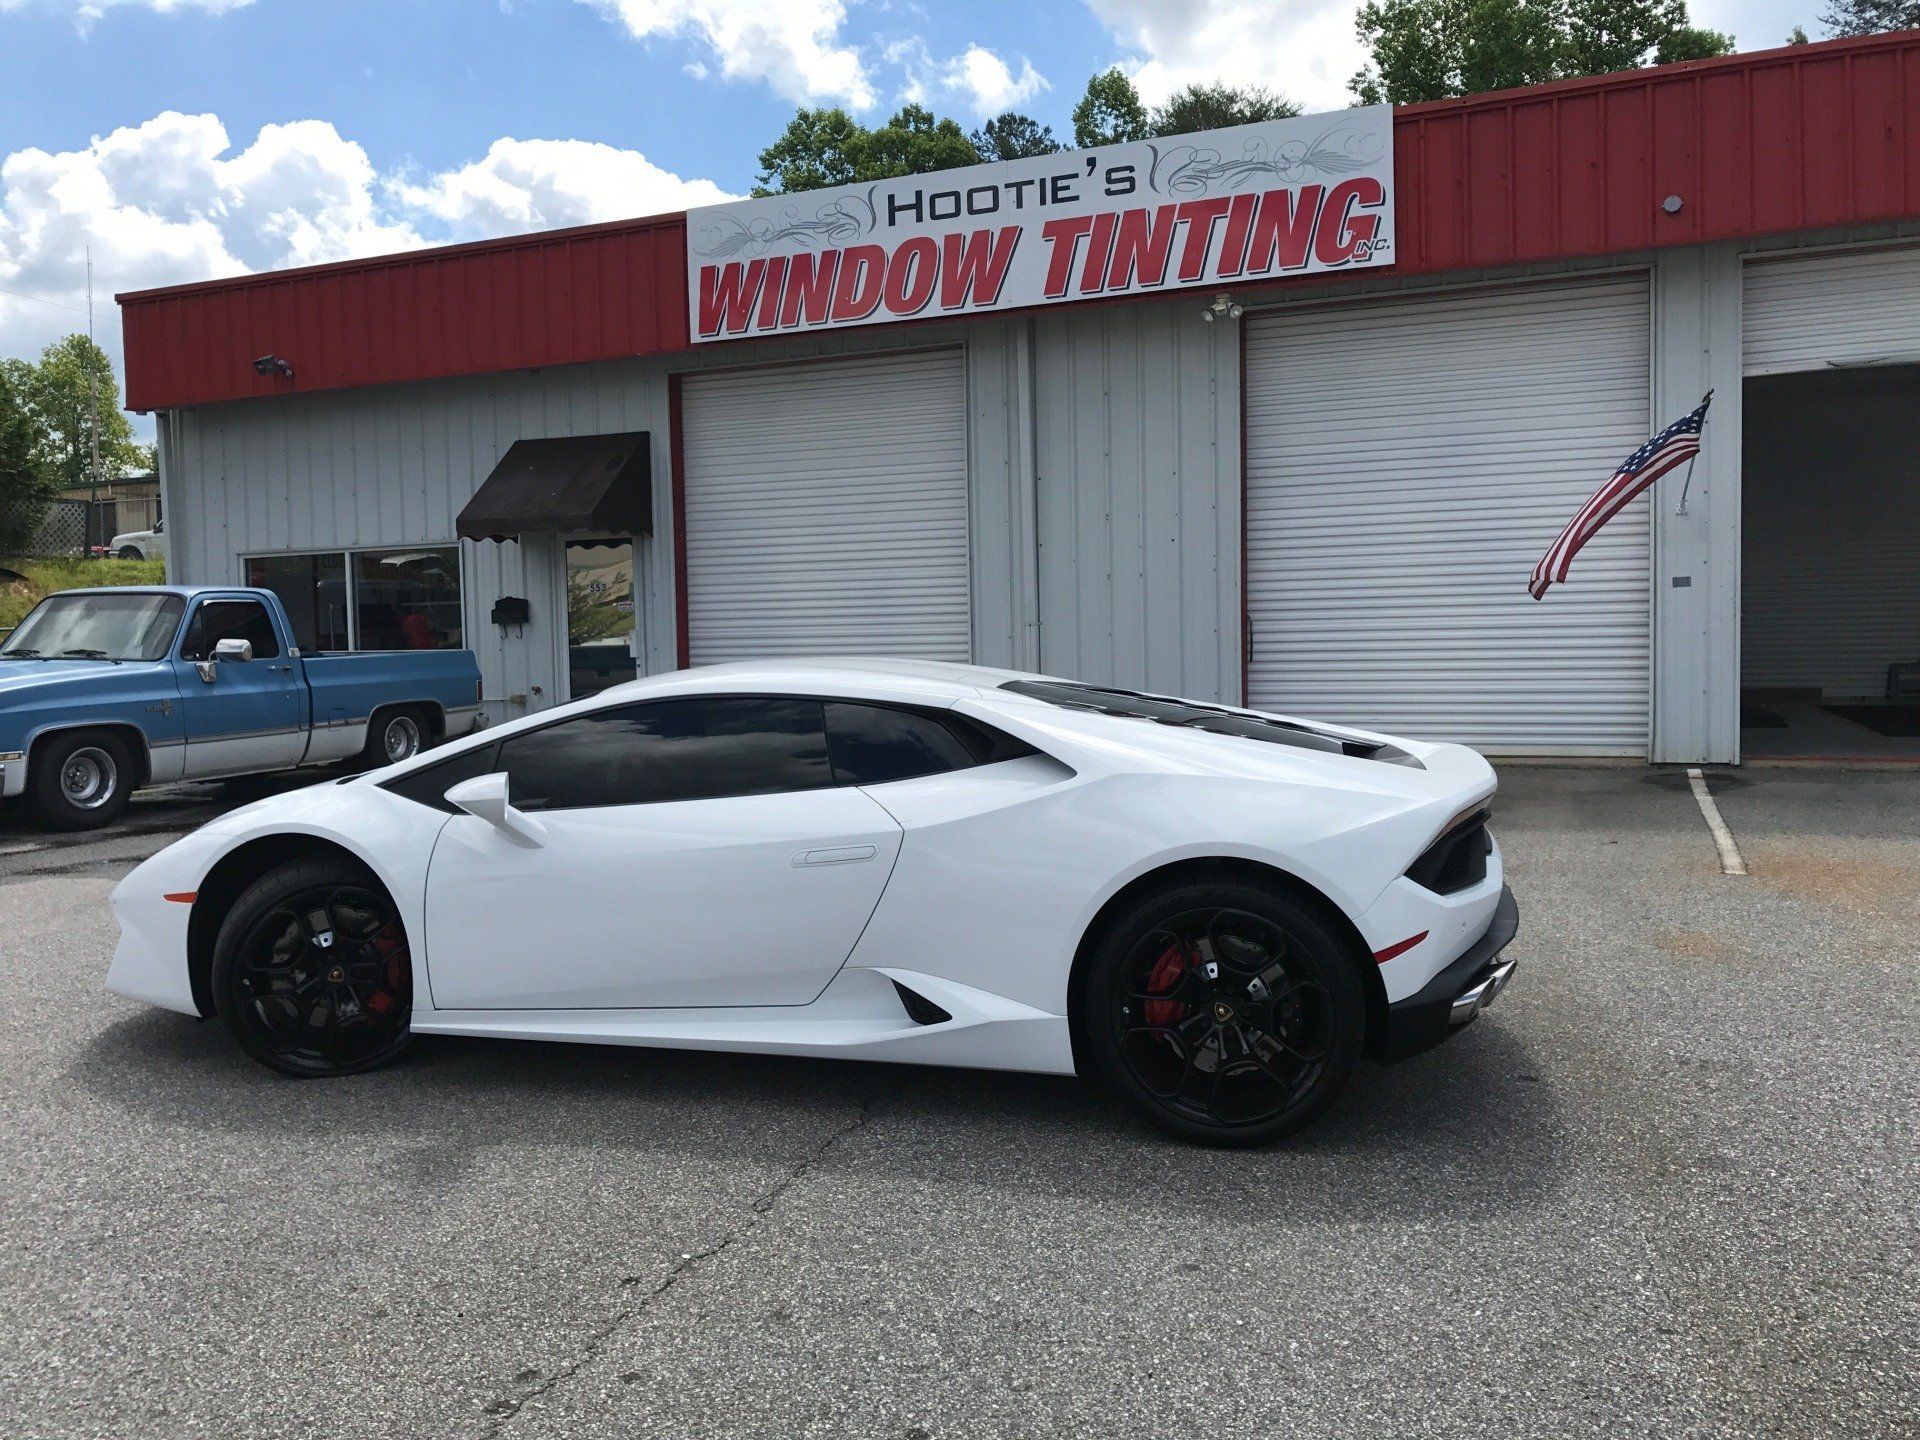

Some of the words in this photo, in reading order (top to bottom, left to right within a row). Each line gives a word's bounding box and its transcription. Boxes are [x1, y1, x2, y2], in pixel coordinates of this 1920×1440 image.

[888, 157, 1136, 226] HOOTIE'S
[698, 225, 1024, 337] WINDOW
[1042, 177, 1386, 299] TINTING
[1356, 239, 1390, 253] INC.
